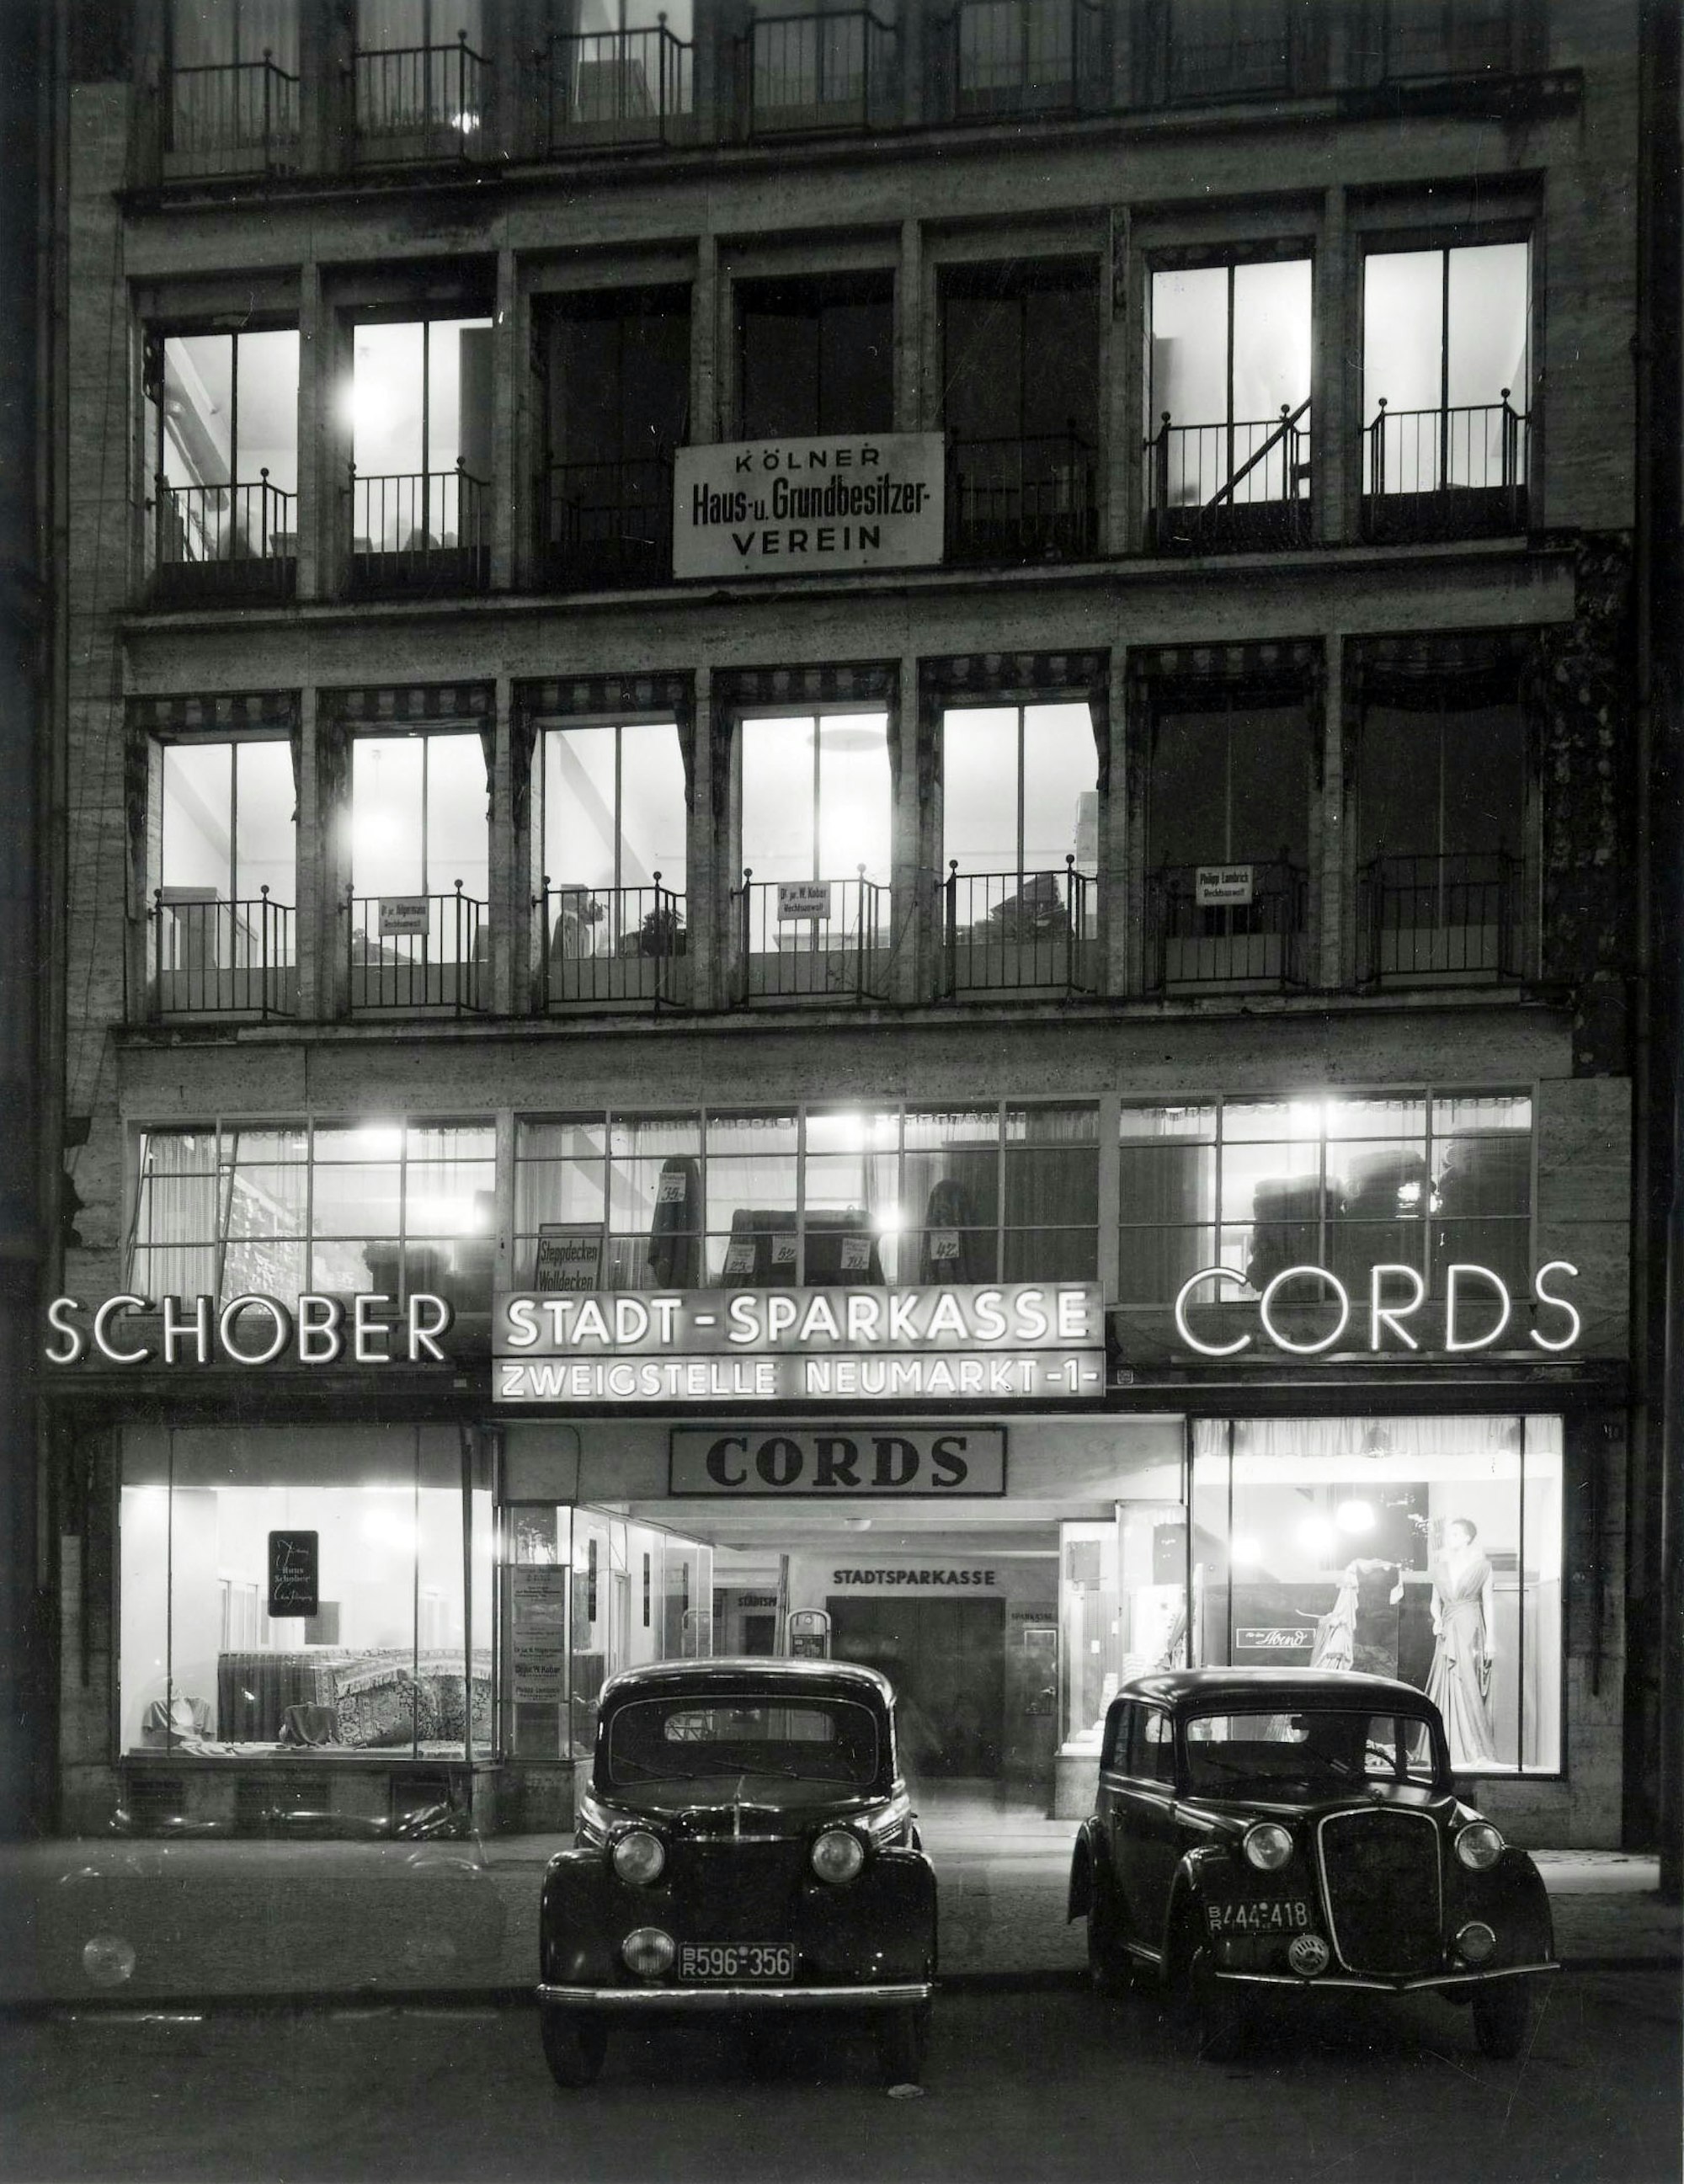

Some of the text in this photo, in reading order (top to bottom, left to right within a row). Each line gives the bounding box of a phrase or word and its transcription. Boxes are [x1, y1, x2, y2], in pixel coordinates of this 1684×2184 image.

[736, 448, 880, 473] KÖLNER
[772, 472, 930, 520] Grundbesitzer-
[732, 525, 881, 556] VEREIN
[541, 1238, 597, 1266] Steppdecken
[539, 1270, 593, 1292] Wolldecken
[507, 1297, 682, 1346] STADT
[727, 1291, 1088, 1344] SPARKASSE
[1175, 1261, 1580, 1356] CORDS
[45, 1294, 453, 1365] SCHOBER
[501, 1361, 776, 1397] ZWEIGSTELLE
[805, 1359, 1037, 1394] NEUMARKT
[706, 1436, 968, 1488] CORDS
[833, 1569, 996, 1586] STADTSPARKASSE
[1255, 1630, 1308, 1646] Abend
[697, 1947, 790, 1975] 596-356
